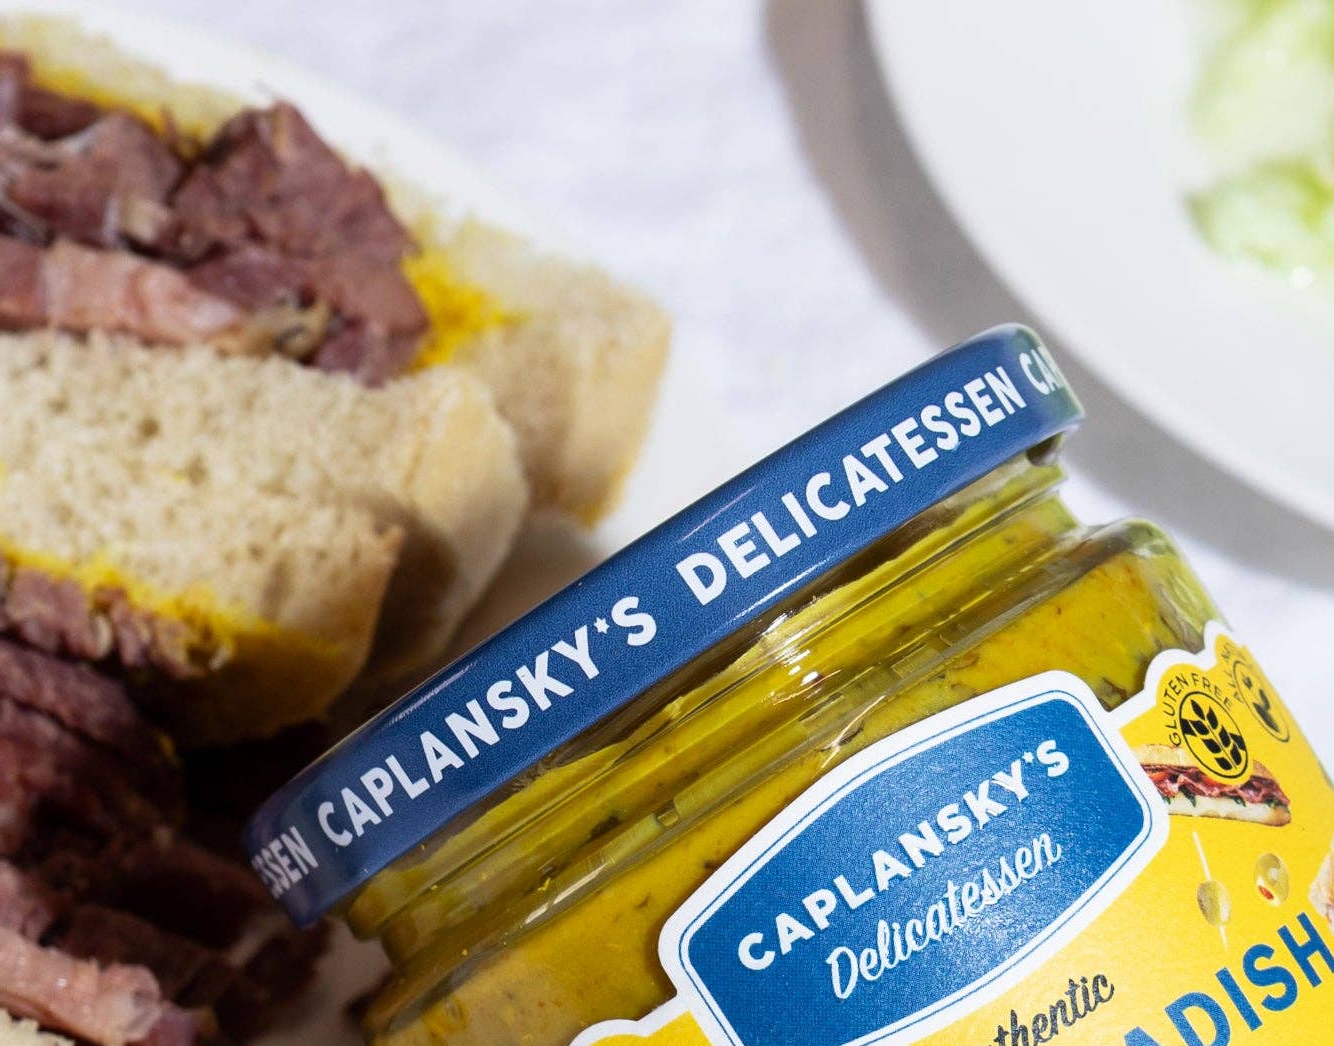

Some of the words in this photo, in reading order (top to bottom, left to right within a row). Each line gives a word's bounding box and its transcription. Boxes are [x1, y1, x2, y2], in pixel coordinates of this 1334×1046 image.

[318, 595, 657, 847] CAPLANSKY'S
[675, 366, 1027, 605] DELICATESSEN
[1163, 673, 1189, 748] GLUTEN
[1191, 672, 1233, 710] FREE
[737, 739, 1070, 971] CAPLANSKY'S
[825, 830, 1062, 1000] Delicatessen
